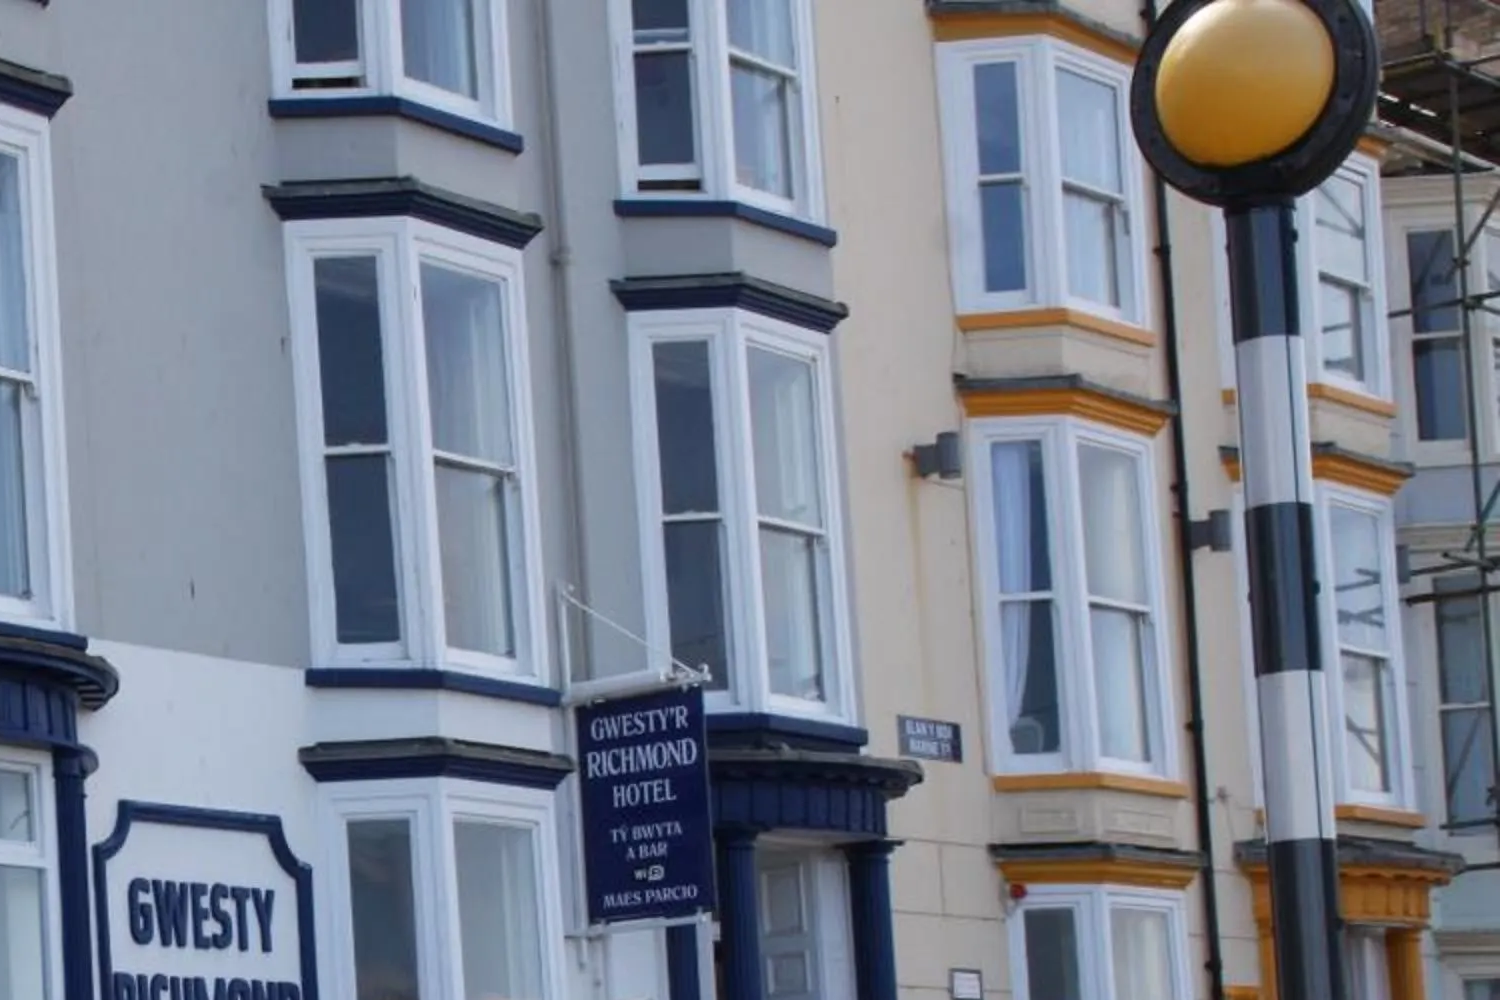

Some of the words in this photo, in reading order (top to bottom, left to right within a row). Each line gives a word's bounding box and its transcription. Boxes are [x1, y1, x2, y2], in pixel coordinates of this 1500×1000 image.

[591, 705, 688, 741] GWESTY'R
[587, 738, 697, 779] RICHMOND
[612, 778, 677, 809] HOTEL
[632, 821, 683, 840] BWYTA
[626, 846, 635, 861] A
[639, 841, 668, 860] BAR
[603, 890, 642, 909] MAES
[645, 884, 698, 904] PARCIO
[127, 877, 275, 953] GWESTY
